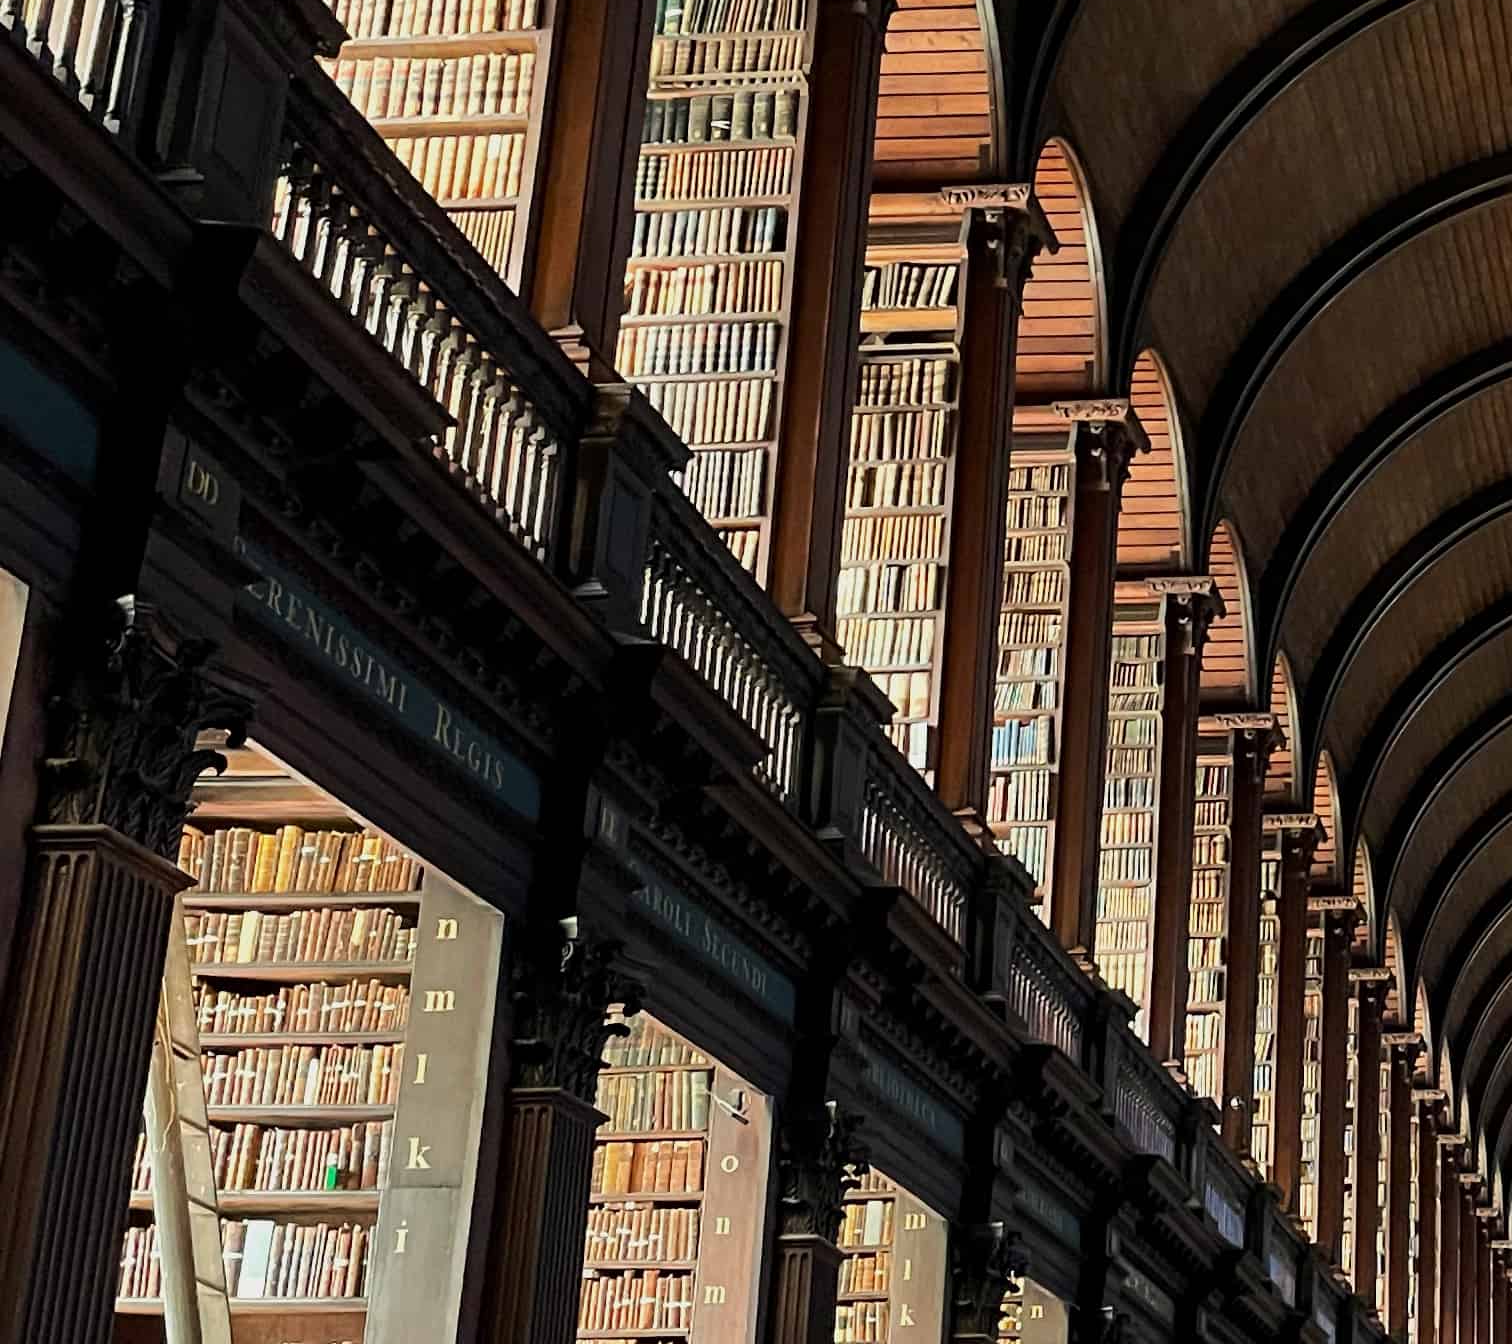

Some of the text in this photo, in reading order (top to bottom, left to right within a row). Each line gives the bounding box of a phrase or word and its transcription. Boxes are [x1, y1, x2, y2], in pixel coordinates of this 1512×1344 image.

[236, 536, 505, 790] RENISSIMI REGIS
[630, 860, 691, 937] AROLI
[436, 917, 458, 940] n
[423, 990, 456, 1012] m
[413, 1054, 427, 1084] l
[405, 1138, 432, 1169] k
[720, 1155, 739, 1173] o
[714, 1216, 730, 1234] n
[904, 1214, 927, 1230] m
[393, 1221, 409, 1253] i
[904, 1259, 912, 1280] l
[703, 1286, 726, 1305] m
[900, 1304, 915, 1326] k
[1030, 1304, 1044, 1319] n
